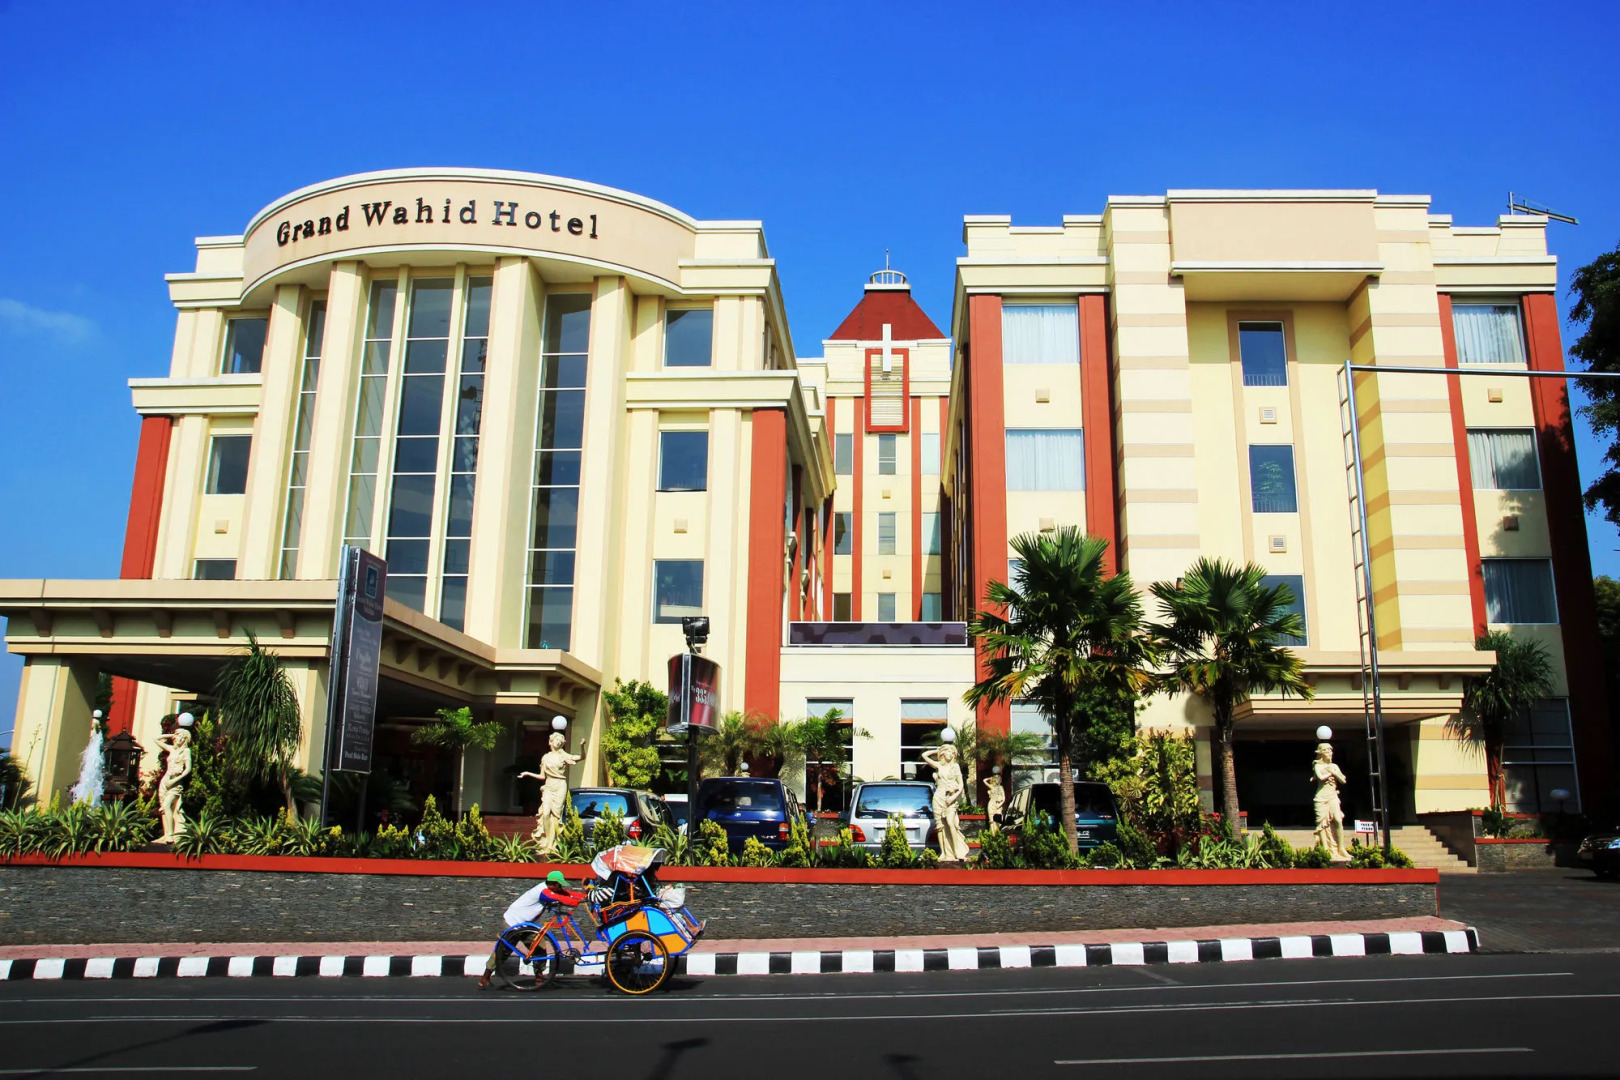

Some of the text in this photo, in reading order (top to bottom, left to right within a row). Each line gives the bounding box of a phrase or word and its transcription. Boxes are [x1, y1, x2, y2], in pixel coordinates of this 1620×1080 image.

[277, 197, 598, 247] Grand Wahid Hotel
